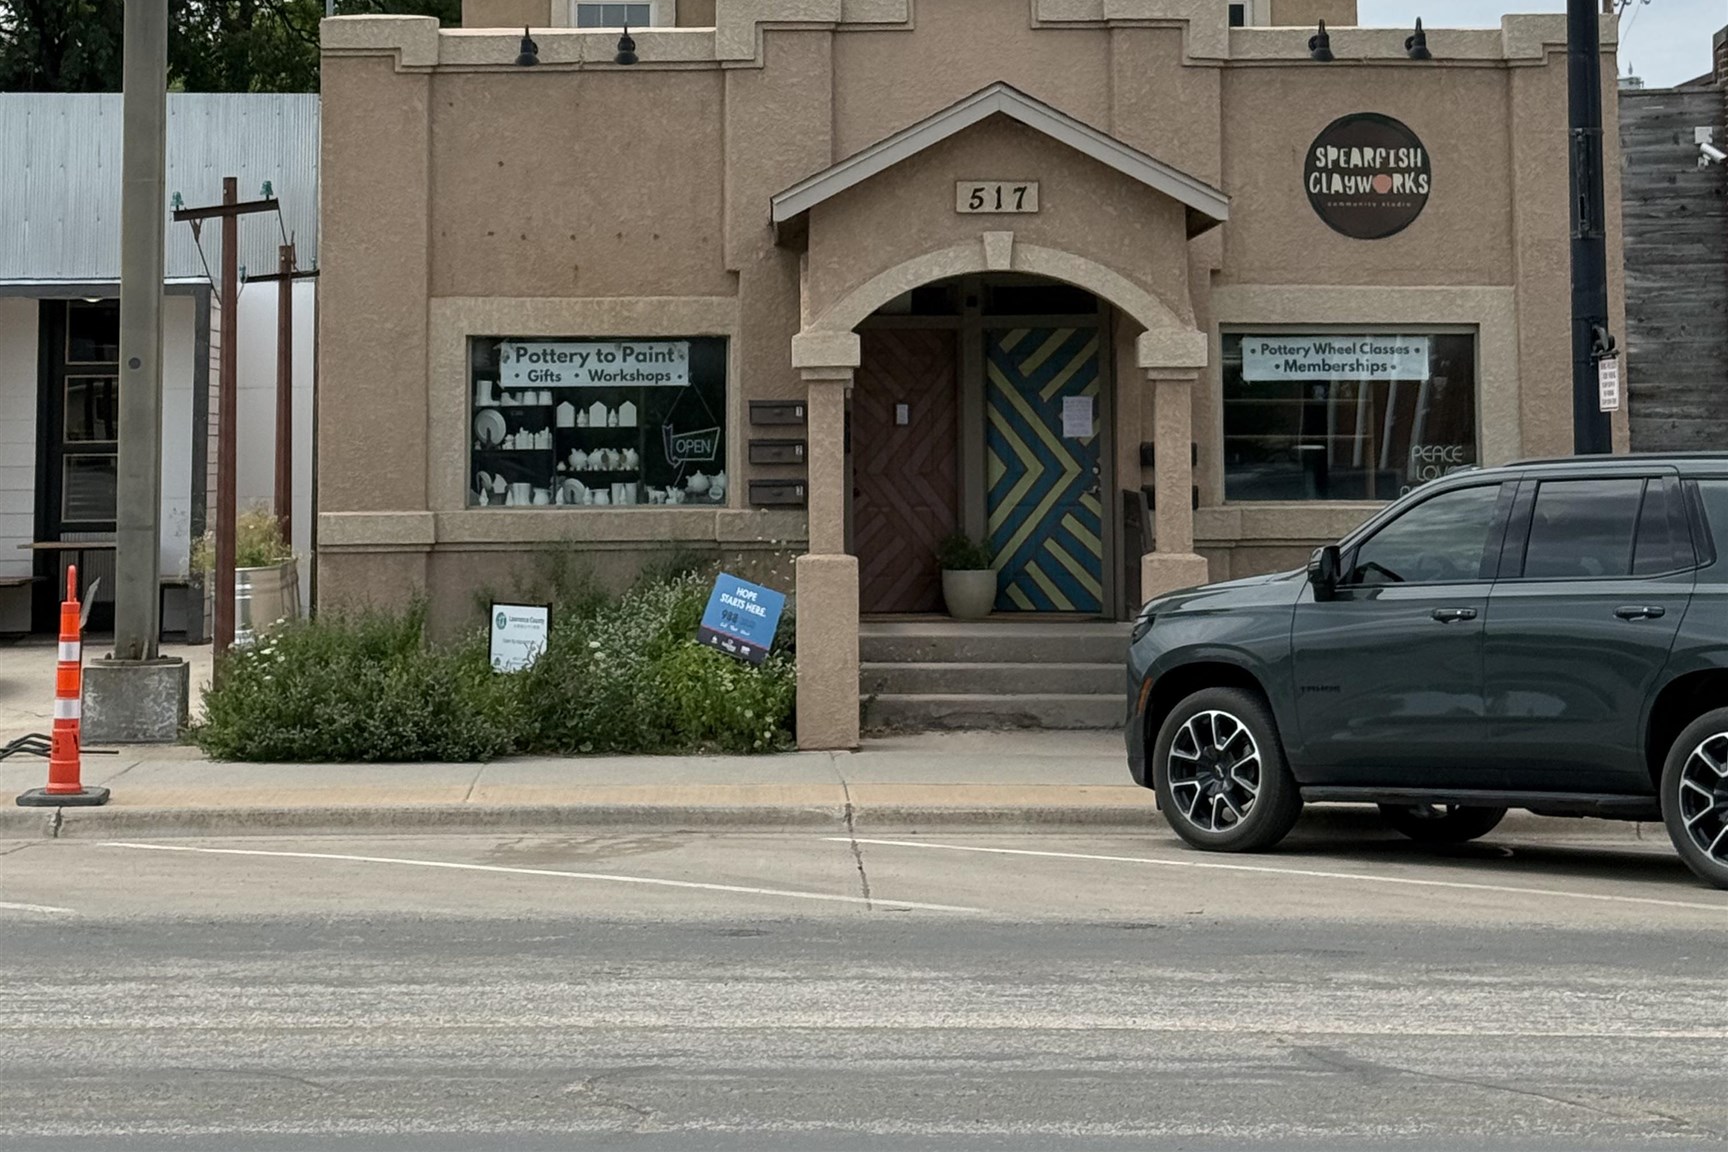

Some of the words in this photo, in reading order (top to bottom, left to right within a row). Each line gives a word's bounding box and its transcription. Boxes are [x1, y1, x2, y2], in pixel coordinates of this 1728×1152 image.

[1315, 145, 1422, 169] SPEARFISH
[1309, 171, 1429, 195] CLAYWORKS
[968, 184, 1028, 210] 517
[515, 346, 590, 368] Pottery
[596, 347, 616, 364] to
[622, 346, 675, 364] Paint
[1260, 343, 1311, 358] Pottery
[1313, 342, 1356, 356] Wheel
[1359, 342, 1410, 356] Classes
[1283, 358, 1388, 375] Memberships
[527, 369, 562, 383] Gifts
[588, 368, 672, 385] Workshops
[675, 439, 711, 454] OPEN
[1411, 445, 1463, 462] PEACE
[1416, 465, 1449, 482] LOV
[719, 593, 745, 610] STARTS
[735, 587, 758, 602] HOPE
